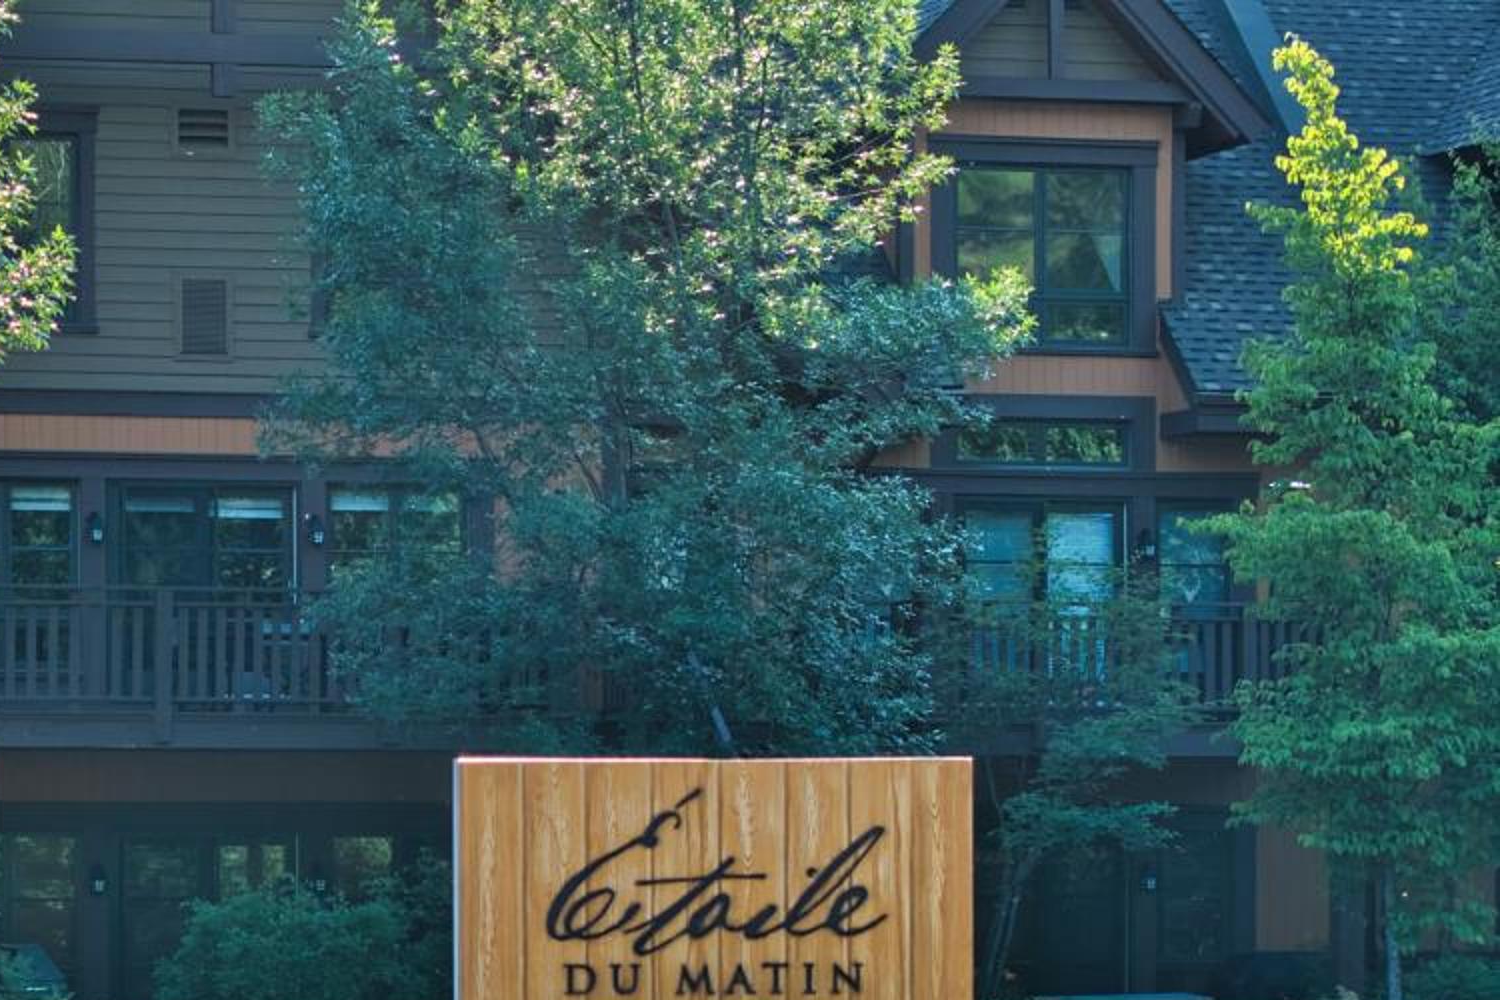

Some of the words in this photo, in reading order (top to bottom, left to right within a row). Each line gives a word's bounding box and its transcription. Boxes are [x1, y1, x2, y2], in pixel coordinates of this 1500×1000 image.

[547, 787, 888, 956] Étoile
[563, 964, 641, 995] DU
[677, 963, 864, 995] MATIN
